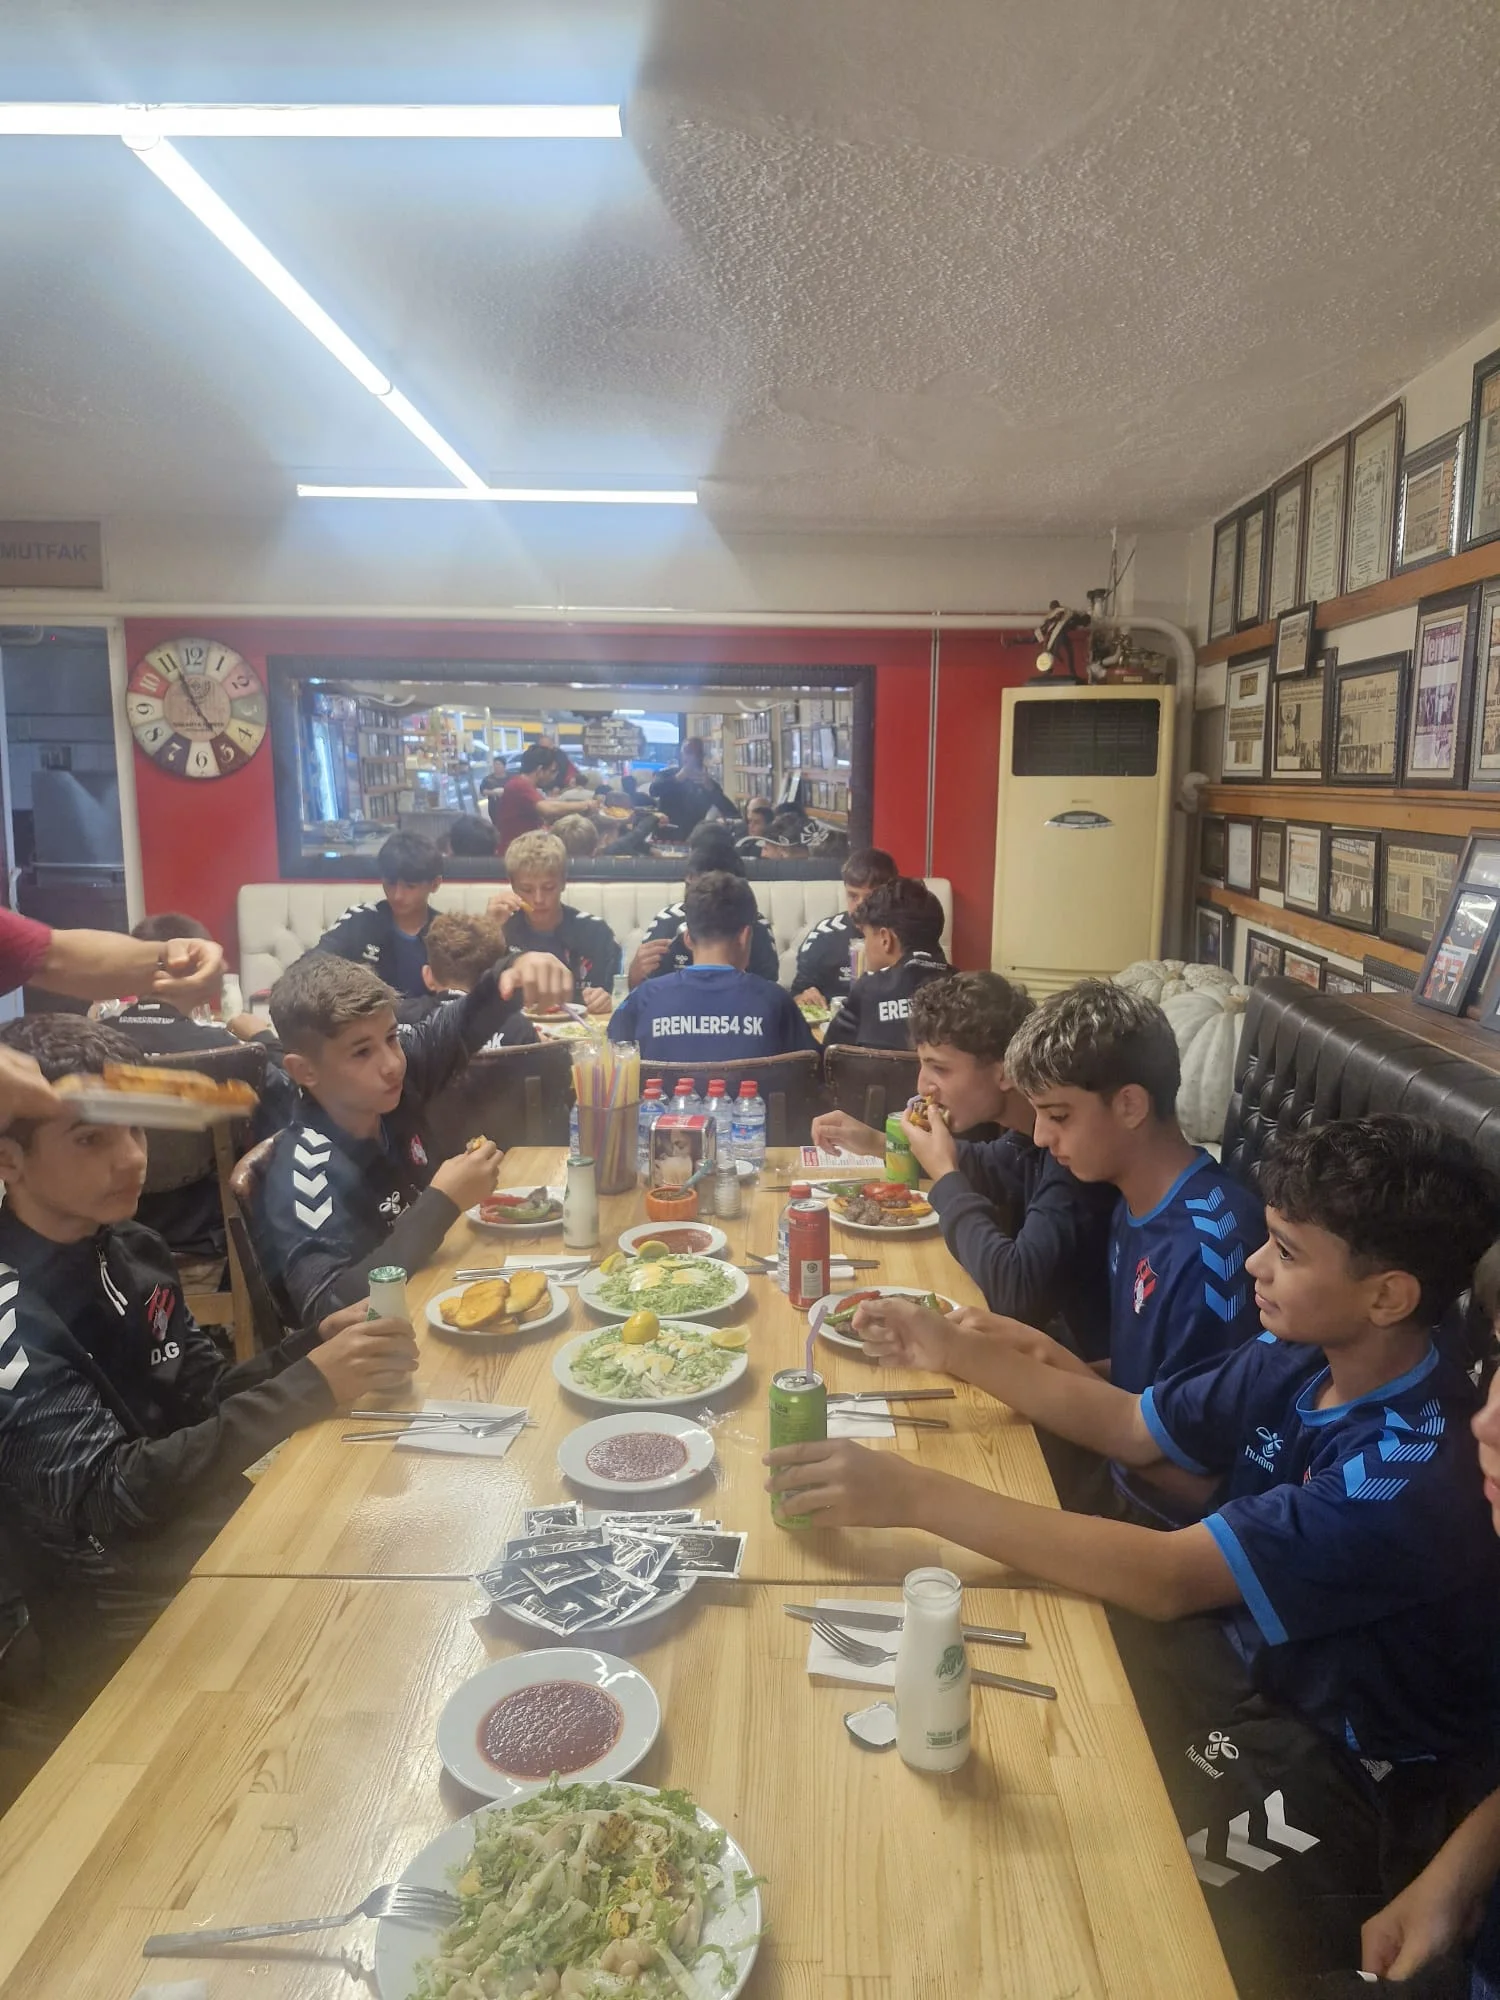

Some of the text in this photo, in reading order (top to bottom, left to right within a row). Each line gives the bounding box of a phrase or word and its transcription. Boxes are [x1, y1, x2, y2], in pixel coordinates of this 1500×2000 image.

[0, 544, 88, 561] MUTFAK
[158, 653, 178, 673] 11
[185, 647, 204, 666] 12
[215, 655, 225, 672] 1
[139, 672, 161, 692] 10
[231, 675, 251, 690] 2
[136, 703, 155, 716] 9
[145, 727, 164, 742] 8
[238, 727, 253, 742] 4
[167, 743, 183, 761] 7
[195, 751, 208, 769] 6
[220, 743, 235, 763] 5
[652, 1015, 764, 1038] ERENLER54 SK
[150, 1341, 180, 1366] D.G
[1184, 1744, 1225, 1780] hummel
